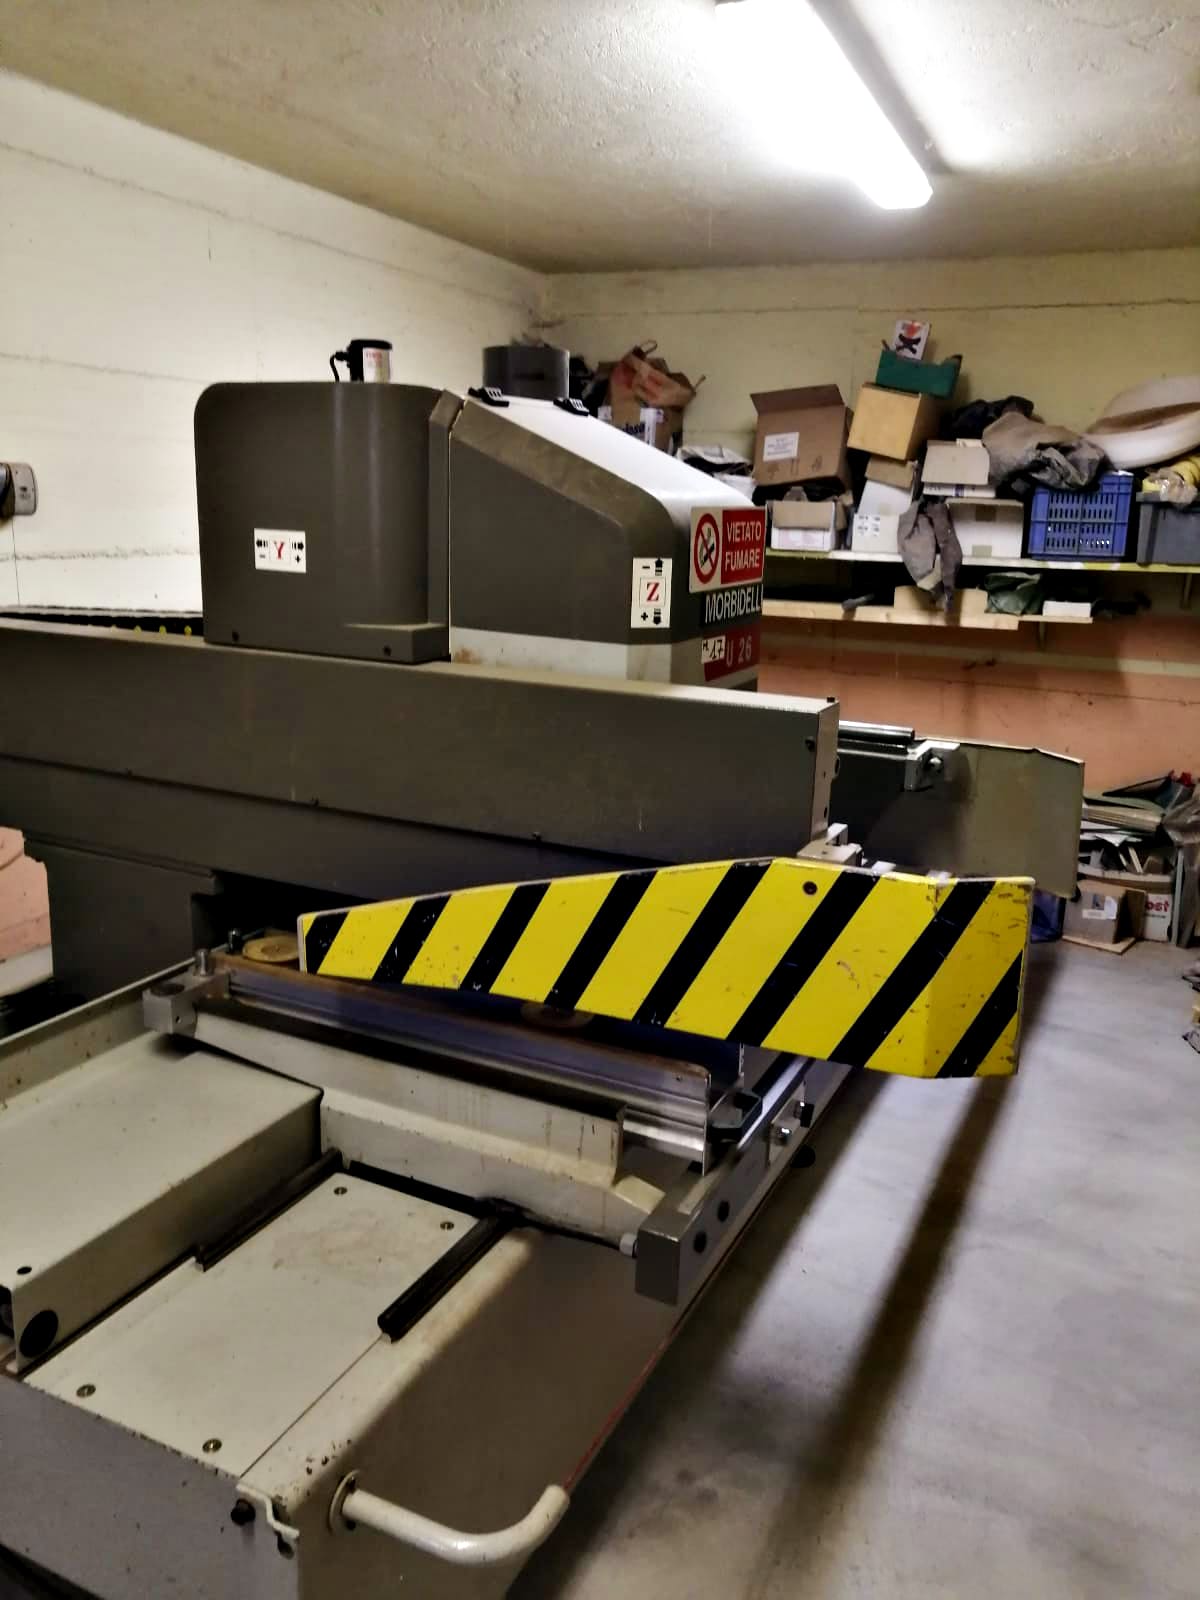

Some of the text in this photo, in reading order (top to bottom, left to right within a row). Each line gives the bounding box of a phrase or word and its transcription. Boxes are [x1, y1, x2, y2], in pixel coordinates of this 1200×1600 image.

[727, 521, 761, 542] VIETATO
[274, 540, 284, 560] Y
[725, 549, 760, 571] FUMARE
[647, 582, 659, 601] Z
